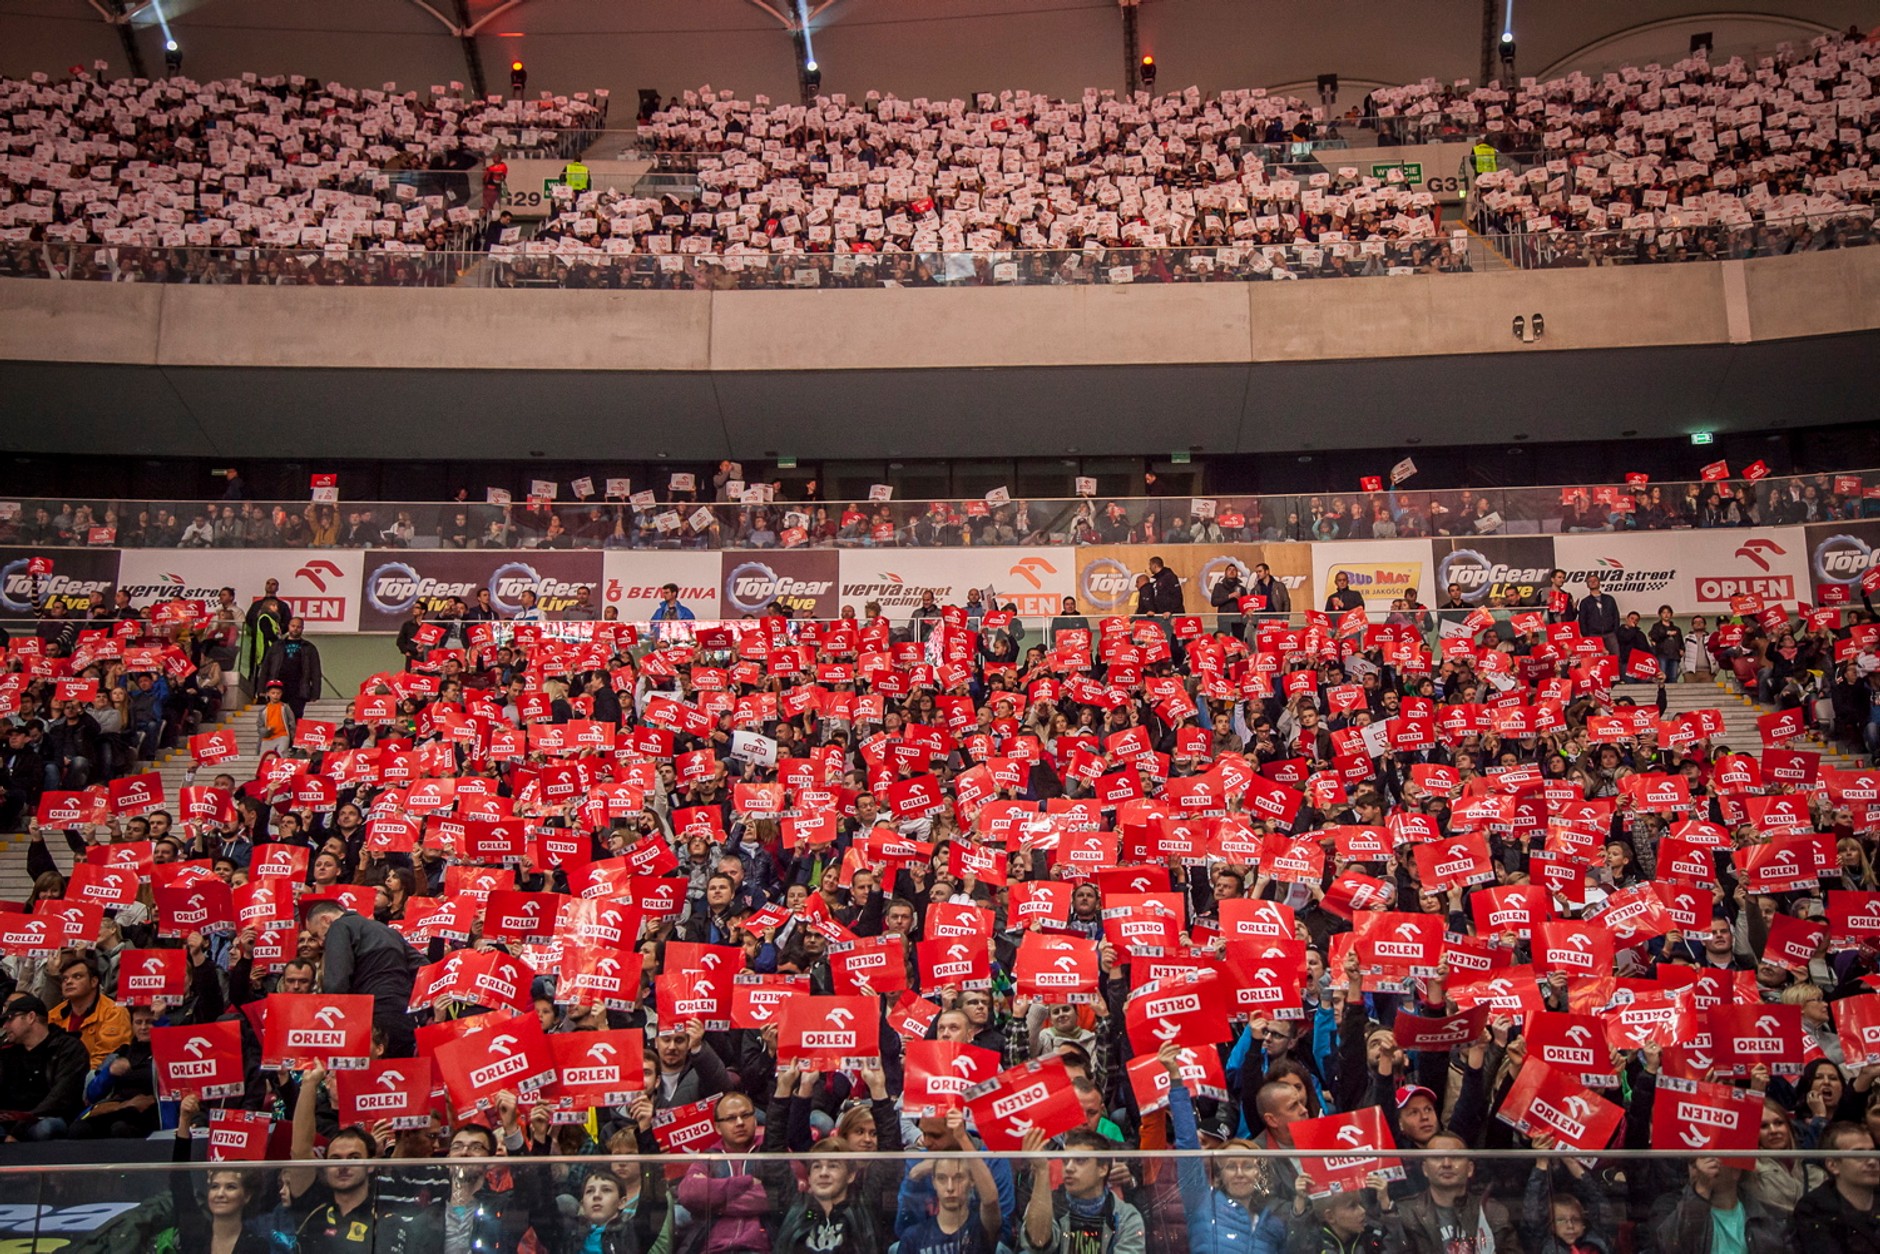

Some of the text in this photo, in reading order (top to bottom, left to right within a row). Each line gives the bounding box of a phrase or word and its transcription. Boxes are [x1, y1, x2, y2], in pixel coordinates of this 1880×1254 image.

[1625, 569, 1676, 581] street
[627, 587, 716, 599] BENINA
[842, 583, 903, 596] verva
[744, 744, 766, 755] ORLEN
[119, 792, 149, 806] ORLEN
[411, 796, 439, 804] ORLEN
[1182, 796, 1210, 805] ORLEN
[1648, 793, 1677, 801] ORLEN
[1844, 790, 1875, 798] ORLEN
[901, 795, 929, 809] ORLEN
[1255, 796, 1283, 814] ORLEN
[51, 811, 78, 819] ORLEN
[1468, 809, 1498, 817] ORLEN
[1766, 815, 1796, 824] ORLEN
[373, 824, 405, 833] ORLEN
[1561, 833, 1591, 844] ORLEN
[547, 841, 576, 853] ORLEN
[1160, 840, 1190, 851] ORLEN
[1223, 841, 1254, 852] ORLEN
[632, 846, 659, 865] ORLEN
[1071, 850, 1102, 860] ORLEN
[259, 864, 290, 874] ORLEN
[1275, 856, 1308, 870] ORLEN
[1436, 859, 1472, 875] ORLEN
[1673, 861, 1707, 875] ORLEN
[1545, 865, 1574, 878] ORLEN
[1761, 865, 1797, 877] ORLEN
[84, 885, 120, 898] ORLEN
[582, 882, 612, 899] ORLEN
[241, 902, 275, 919] ORLEN
[643, 899, 671, 909] ORLEN
[1020, 903, 1050, 912] ORLEN
[175, 909, 206, 923] ORLEN
[419, 914, 453, 925] ORLEN
[1492, 910, 1527, 923] ORLEN
[503, 917, 537, 929] ORLEN
[1123, 922, 1162, 934] ORLEN
[1239, 922, 1277, 934] ORLEN
[6, 934, 42, 942] ORLEN
[584, 926, 618, 939] ORLEN
[1377, 942, 1421, 956] ORLEN
[847, 954, 884, 969] ORLEN
[1444, 951, 1488, 969] ORLEN
[1548, 950, 1590, 965] ORLEN
[935, 961, 971, 976] ORLEN
[131, 976, 163, 987] ORLEN
[431, 974, 458, 992] ORLEN
[477, 974, 515, 996] ORLEN
[575, 975, 617, 989] ORLEN
[1038, 975, 1077, 984] ORLEN
[1239, 988, 1280, 1002] ORLEN
[677, 999, 714, 1013] ORLEN
[1147, 995, 1197, 1016] ORLEN
[1624, 1010, 1672, 1022] ORLEN
[291, 1031, 342, 1045] ORLEN
[805, 1033, 853, 1046] ORLEN
[1418, 1030, 1466, 1041] ORLEN
[1736, 1040, 1780, 1051] ORLEN
[1545, 1047, 1591, 1063] ORLEN
[171, 1061, 214, 1077] ORLEN
[472, 1054, 526, 1086] ORLEN
[566, 1067, 617, 1083] ORLEN
[358, 1094, 405, 1108] ORLEN
[994, 1084, 1047, 1117] ORLEN
[1531, 1100, 1583, 1137] ORLEN
[1680, 1104, 1735, 1126] ORLEN
[213, 1130, 246, 1146] ORLEN
[671, 1121, 711, 1144] ORLEN
